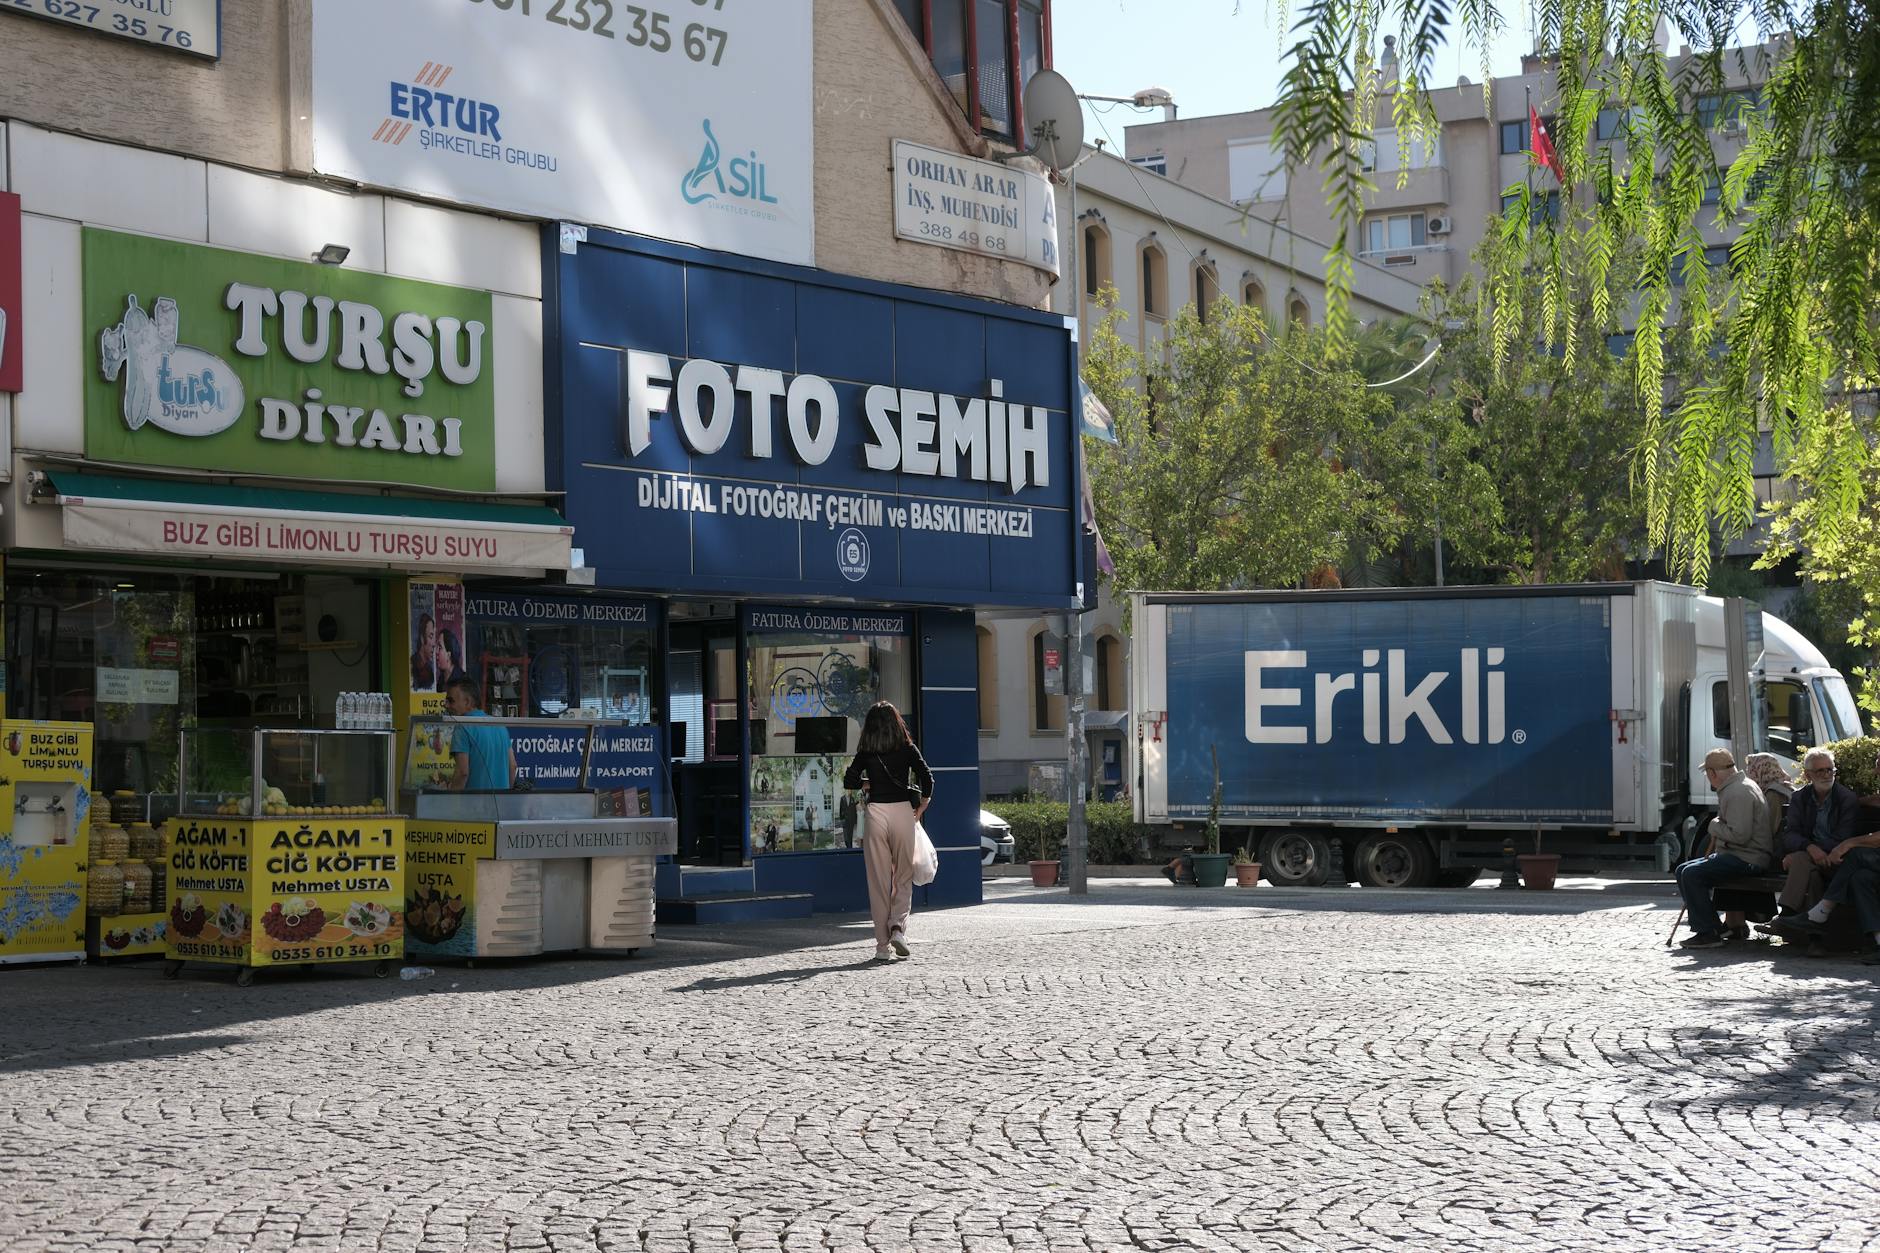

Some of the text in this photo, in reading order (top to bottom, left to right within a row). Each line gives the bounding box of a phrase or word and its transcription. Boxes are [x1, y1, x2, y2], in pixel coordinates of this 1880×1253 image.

[45, 0, 192, 47] 627 35 76
[626, 5, 671, 53] 35
[684, 23, 728, 67] 67
[390, 81, 503, 142] ERTUR
[420, 128, 557, 172] ŞİRKETLER GRUBU
[907, 157, 1018, 200] ORHAN ARAR
[908, 183, 934, 214] İNŞ.
[919, 221, 1006, 250] 388 49 68
[225, 281, 486, 398] TURŞU
[258, 388, 463, 456] DİYARI
[626, 348, 1050, 495] FOTO SEMİH
[637, 473, 1034, 538] DİJİTAL FOTOĞRAF ÇEKİM ve BASKI MERKEZİ
[163, 521, 498, 560] BUZ GİBİ LİMONLU TURŞU SUYU
[464, 599, 647, 622] ATURA ÖDEME MERKEZİ
[751, 612, 904, 633] FATURA ÖDEME MERKEZİ
[422, 699, 438, 708] BUZ
[1244, 648, 1506, 745] Erikli
[31, 732, 78, 745] BUZ GİBİ
[516, 734, 575, 753] FOTOĞRAF
[577, 734, 609, 756] ÇKİM
[611, 734, 654, 752] MERKEZİ
[22, 760, 83, 771] TURŞU SUYU
[534, 764, 592, 778] İZMİRİMKAT
[596, 766, 654, 777] PASAPORT
[175, 822, 227, 846] AĞAM
[270, 824, 361, 849] AĞAM
[446, 829, 487, 845] MİDYECİ
[507, 830, 670, 849] MİDYECİ MEHMET USTA
[200, 850, 247, 872] KÖFTE
[316, 850, 397, 873] KÖFTE
[405, 851, 466, 865] MEHMET
[176, 876, 244, 890] Mehmet USTA
[271, 878, 390, 893] Mehmet USTA
[417, 872, 454, 886] USTA
[177, 942, 244, 958] 0535 610 34 10
[271, 943, 391, 960] 0535 610 34 10
